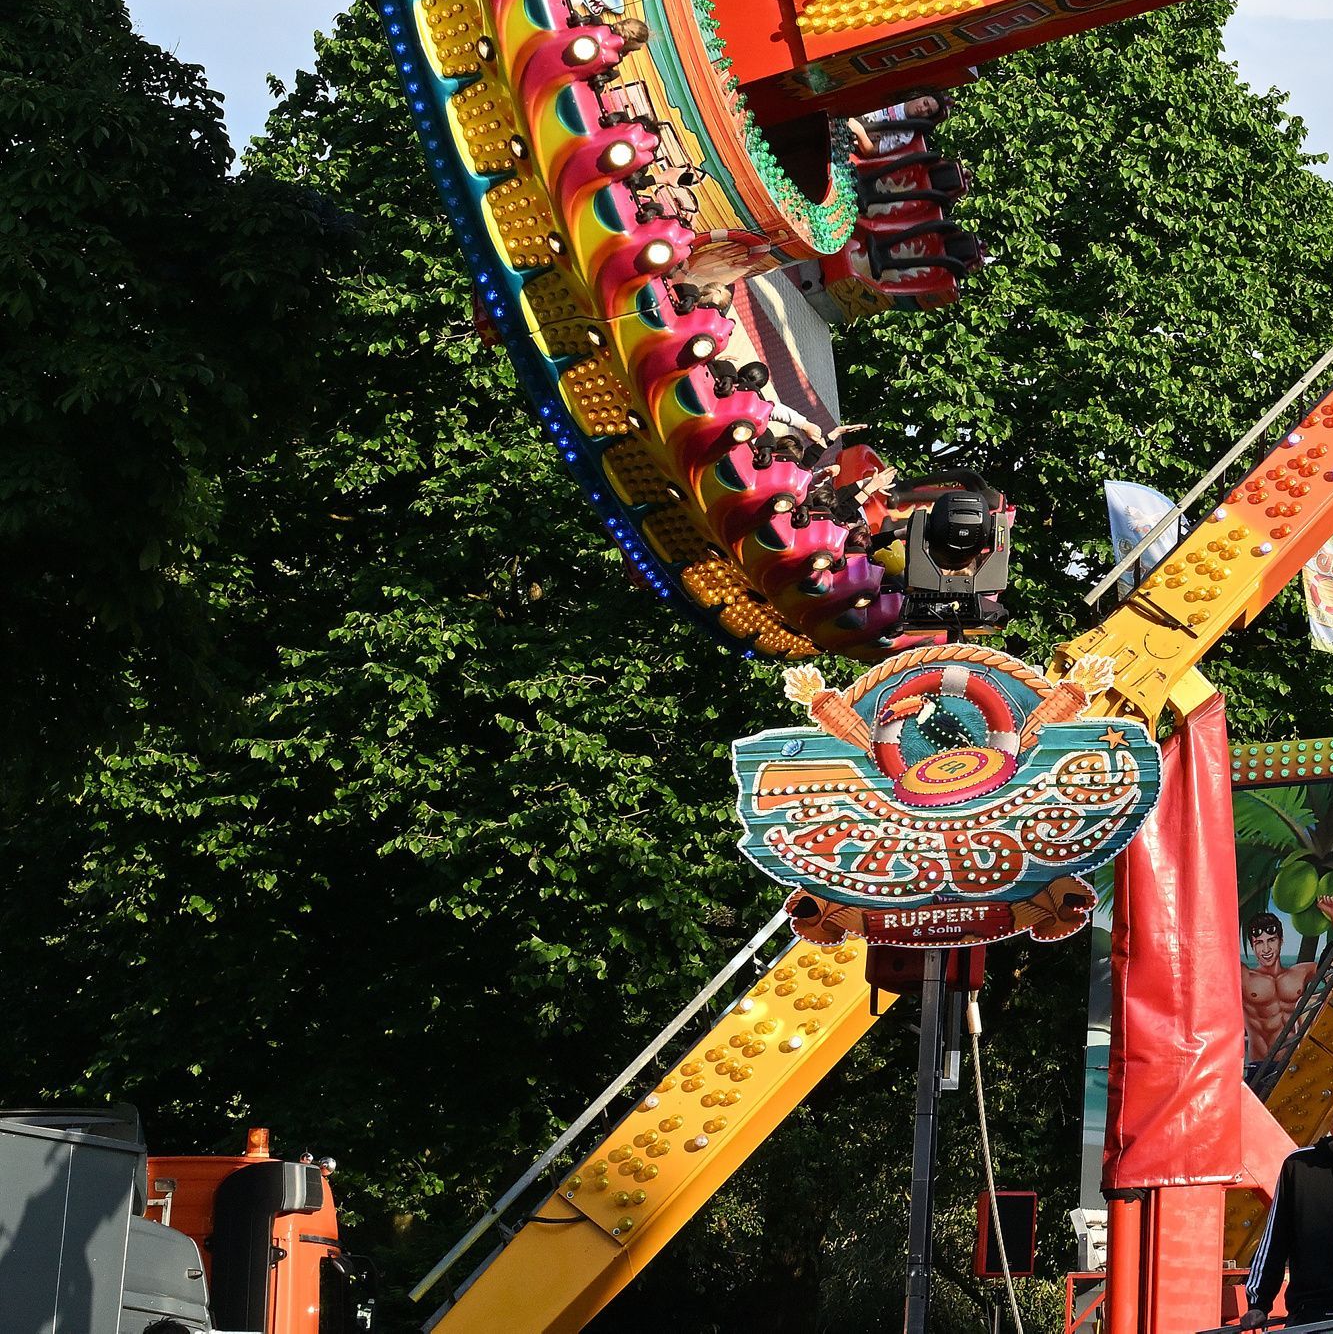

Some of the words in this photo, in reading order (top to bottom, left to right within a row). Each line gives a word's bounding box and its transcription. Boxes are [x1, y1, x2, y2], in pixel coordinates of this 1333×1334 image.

[937, 760, 967, 774] ER
[883, 905, 990, 929] RUPPERT
[912, 926, 923, 937] &
[927, 923, 962, 936] Sohn
